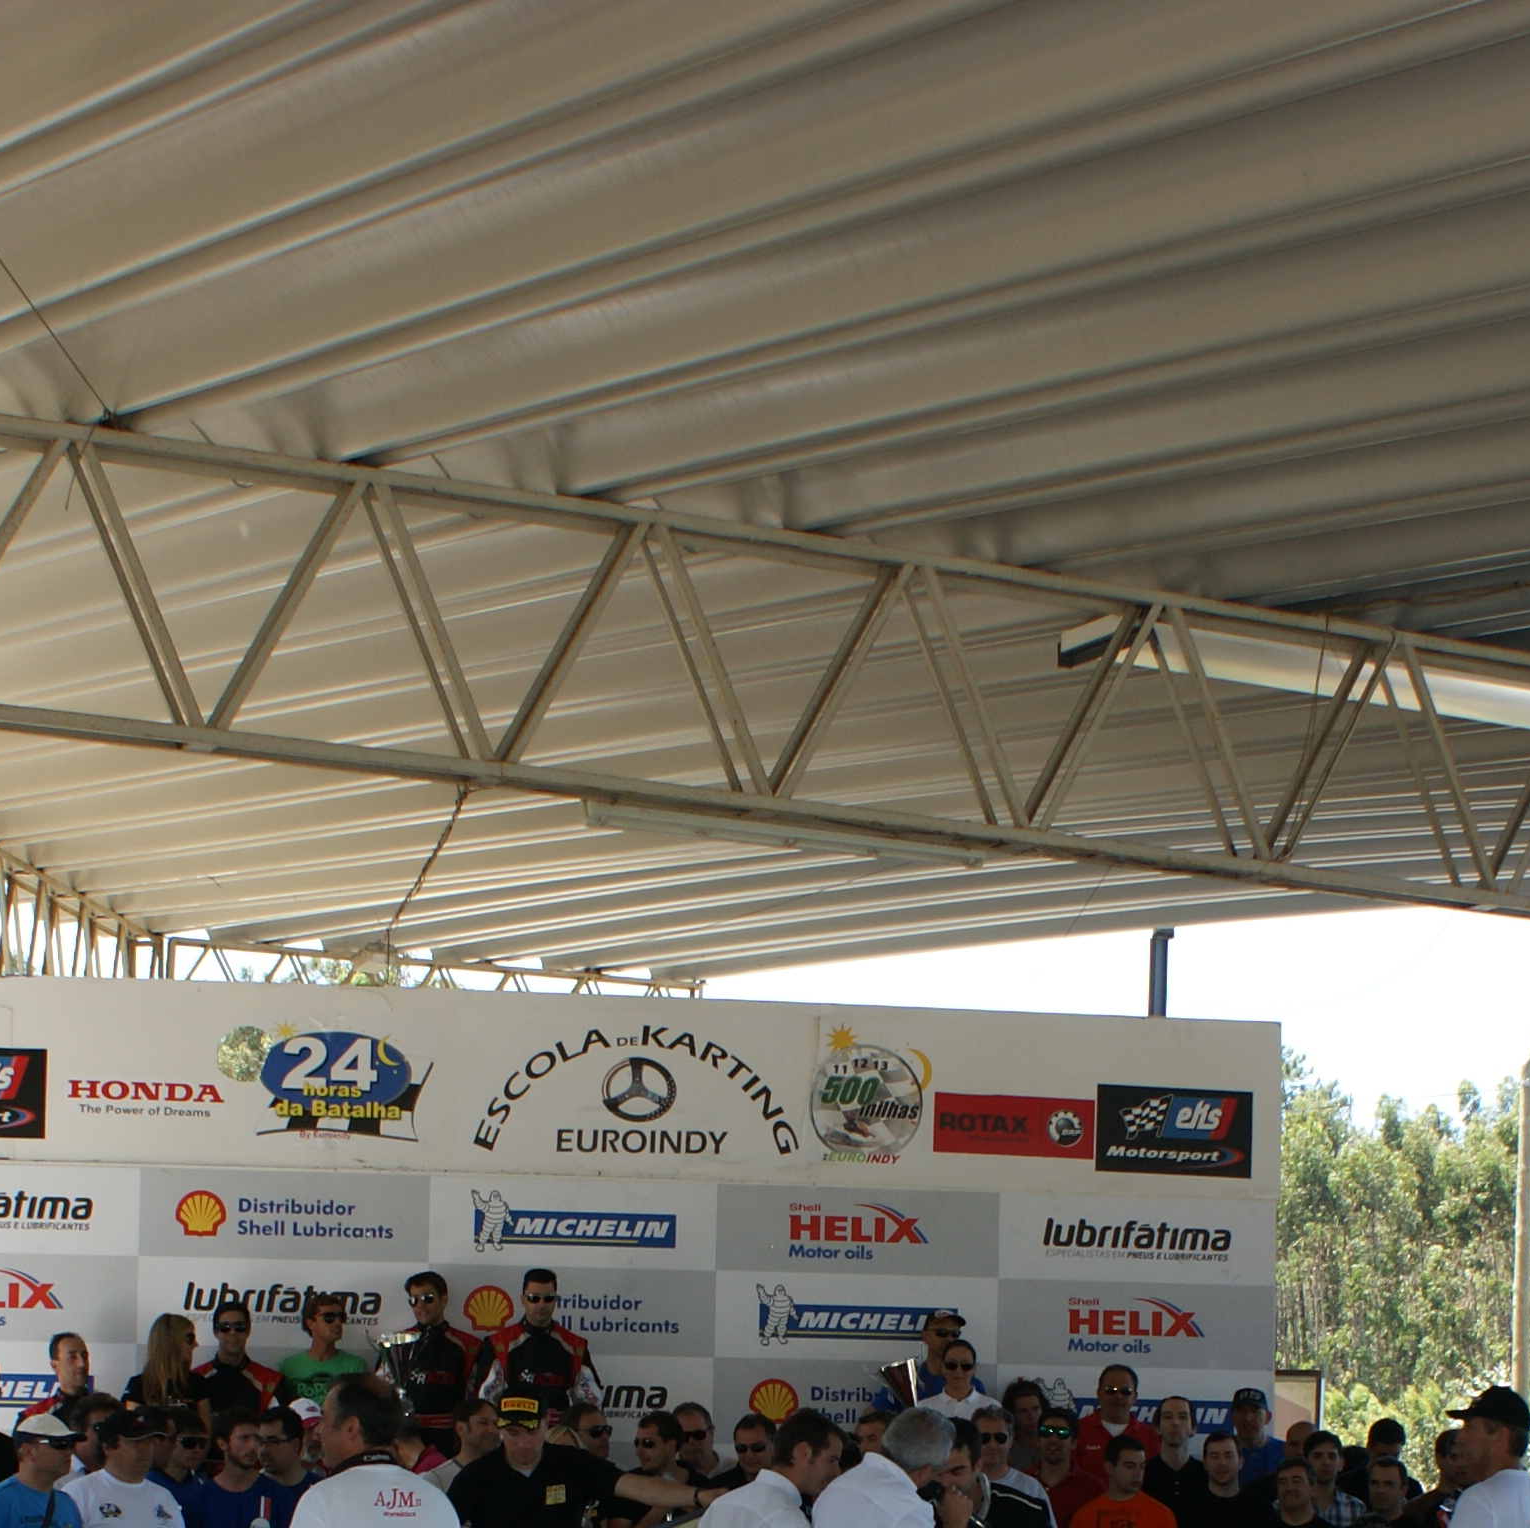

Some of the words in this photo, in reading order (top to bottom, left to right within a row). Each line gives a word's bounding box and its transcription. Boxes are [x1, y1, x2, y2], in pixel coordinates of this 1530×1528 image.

[281, 1037, 378, 1091] 24
[68, 1080, 225, 1103] HONDA
[303, 1081, 362, 1098] horas
[473, 1028, 611, 1152] ESCOLA
[616, 1036, 639, 1046] DE
[641, 1025, 799, 1155] KARTING
[821, 1075, 881, 1105] 500
[79, 1104, 101, 1114] The
[106, 1105, 144, 1115] Power
[149, 1106, 160, 1116] of
[164, 1107, 211, 1117] Dreams
[275, 1100, 303, 1117] da
[311, 1100, 401, 1119] Batalha
[858, 1101, 920, 1120] milhas
[938, 1112, 1028, 1134] ROTAX
[556, 1129, 728, 1154] EUROINDY
[1106, 1145, 1220, 1162] Motorsport
[238, 1198, 356, 1216] Distribuidor
[789, 1203, 821, 1212] Shell
[237, 1220, 285, 1236] Shell
[292, 1222, 394, 1239] Lubricants
[514, 1218, 669, 1238] MICHELIN
[789, 1215, 923, 1244] HELIX
[788, 1245, 840, 1259] Motor
[844, 1246, 873, 1260] oils
[1127, 1252, 1155, 1260] PNEUS
[1069, 1298, 1099, 1306] Shell
[579, 1317, 680, 1334] Lubricants
[1068, 1309, 1200, 1338] HELIX
[1068, 1338, 1119, 1352] Motor
[1122, 1339, 1151, 1354] oils
